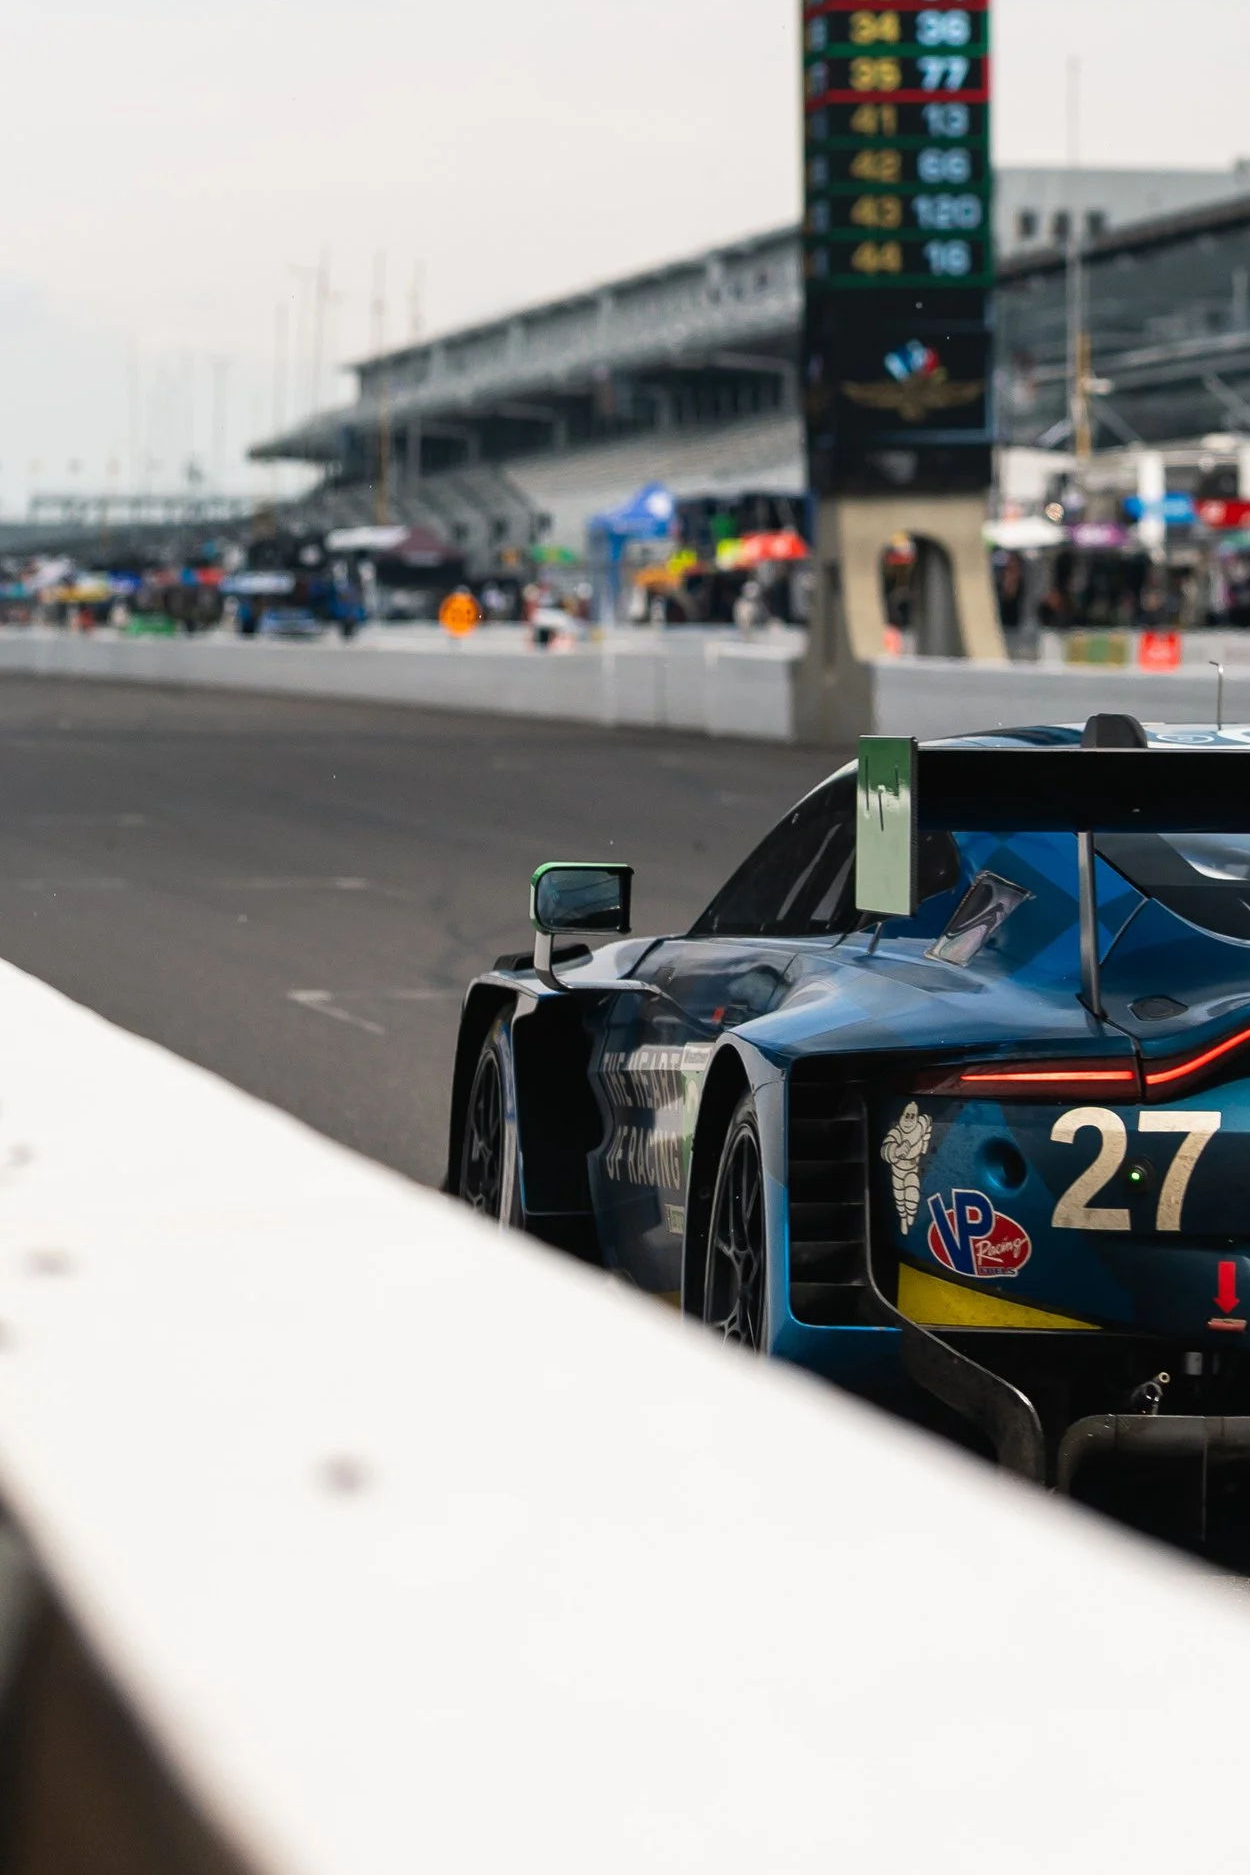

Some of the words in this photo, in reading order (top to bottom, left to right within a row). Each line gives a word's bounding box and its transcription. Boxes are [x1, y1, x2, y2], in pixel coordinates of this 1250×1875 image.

[852, 10, 901, 45] 34
[917, 9, 970, 46] 36
[851, 56, 902, 94] 35
[920, 55, 968, 91] 77
[850, 102, 897, 135] 41
[921, 102, 970, 137] 13
[850, 148, 901, 182] 42
[850, 194, 901, 228] 43
[911, 193, 982, 229] 120
[851, 240, 902, 274] 44
[922, 239, 971, 275] 16
[628, 1051, 683, 1111] HEART
[606, 1126, 629, 1181] OF
[628, 1128, 681, 1190] RACING
[1050, 1106, 1222, 1231] 27
[927, 1189, 996, 1276] VP
[975, 1236, 1027, 1265] Racing
